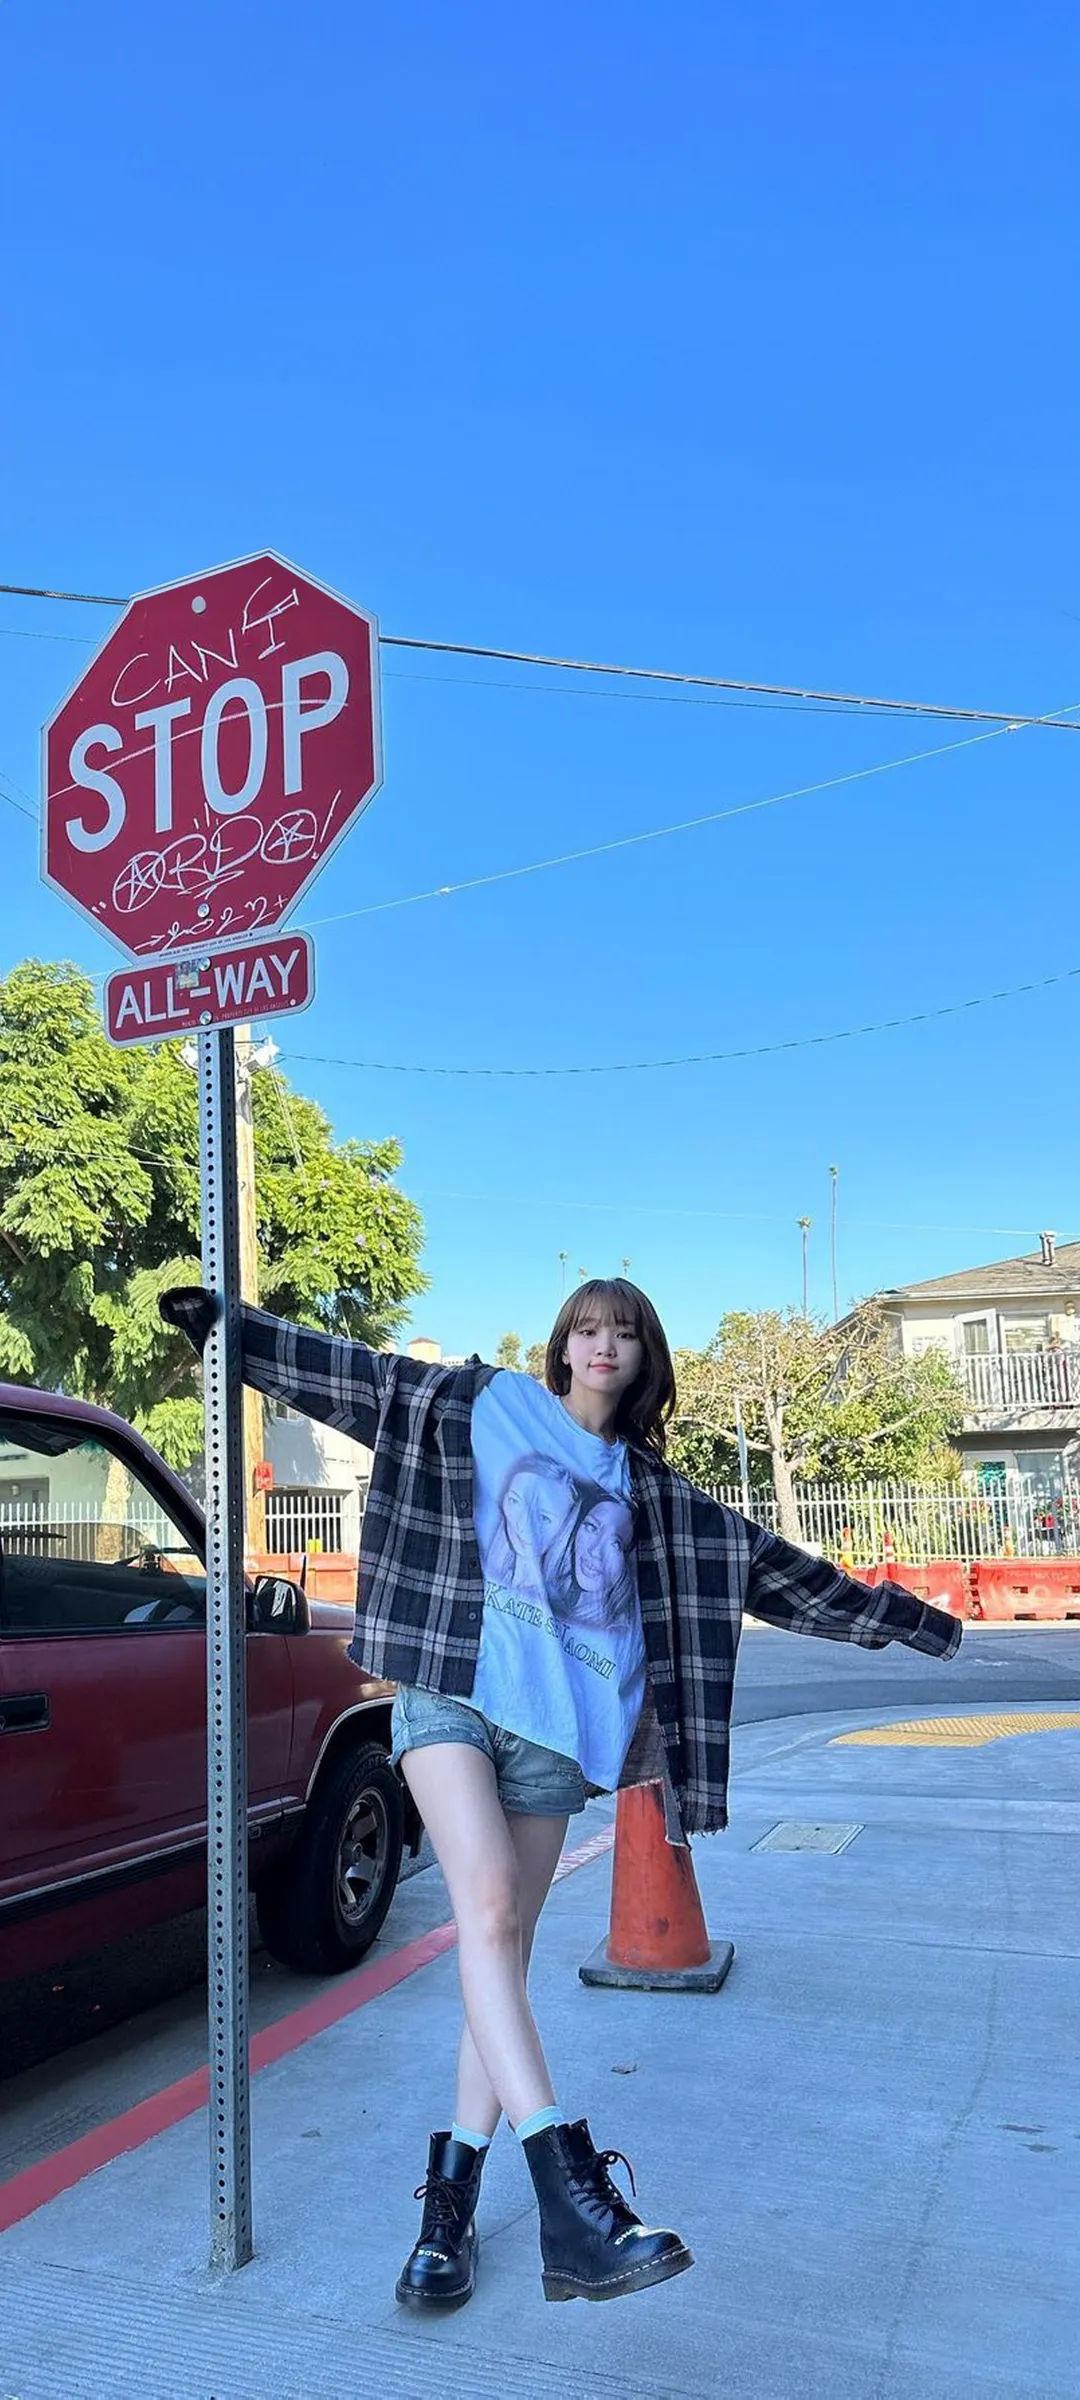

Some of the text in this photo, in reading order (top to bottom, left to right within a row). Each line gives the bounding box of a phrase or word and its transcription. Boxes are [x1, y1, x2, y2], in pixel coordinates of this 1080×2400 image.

[64, 650, 351, 854] STOP
[114, 950, 300, 1029] ALL-WAY
[483, 1580, 544, 1629] KATE
[417, 2249, 449, 2262] MADE
